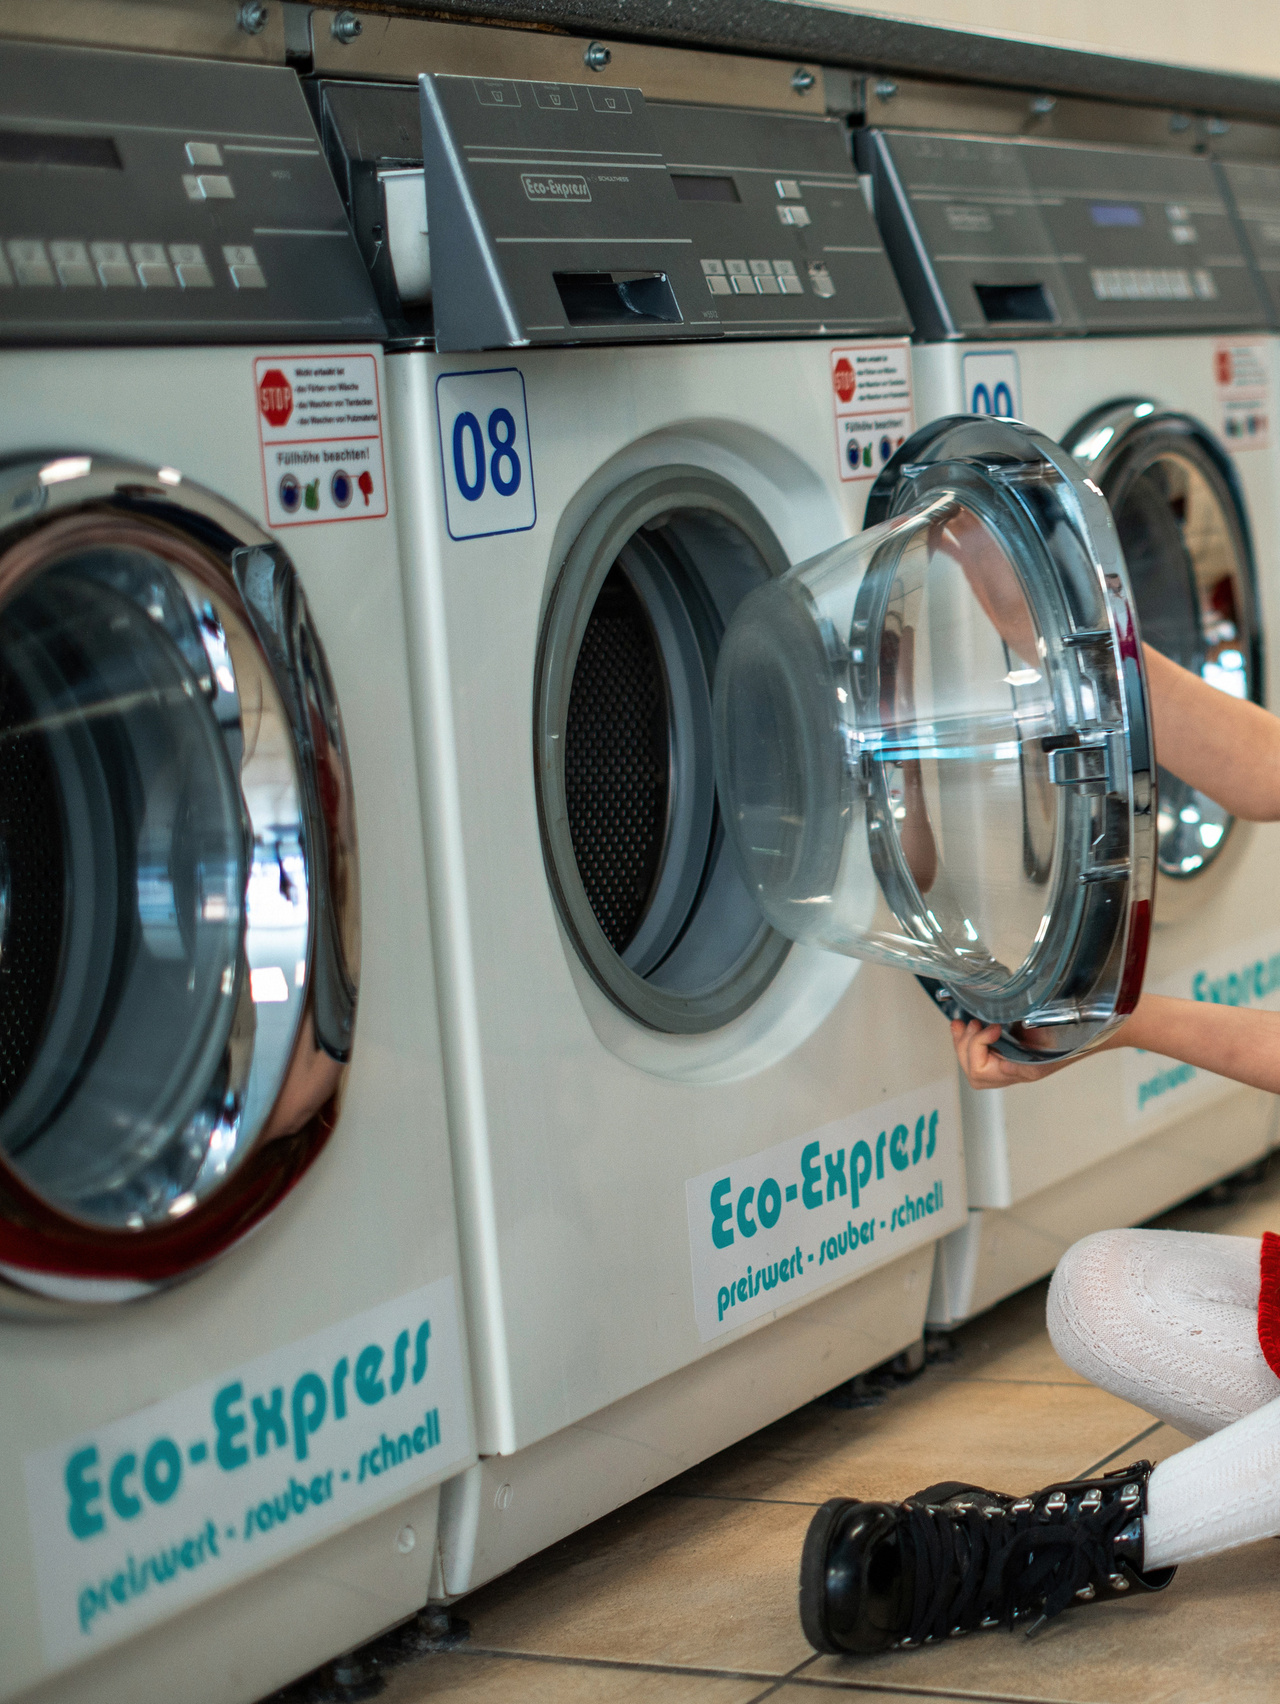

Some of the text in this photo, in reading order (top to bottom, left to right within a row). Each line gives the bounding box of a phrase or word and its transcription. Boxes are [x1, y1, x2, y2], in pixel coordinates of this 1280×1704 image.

[526, 178, 587, 199] Eco-Express
[262, 388, 291, 410] STOP
[277, 448, 369, 465] Füllhöhe beachten!
[453, 407, 521, 501] 08
[709, 1108, 939, 1250] Eco-Express
[717, 1179, 944, 1322] preiswert sauber schnell
[64, 1318, 432, 1541] Eco-Express
[77, 1406, 442, 1635] preiswert sauber schnell
